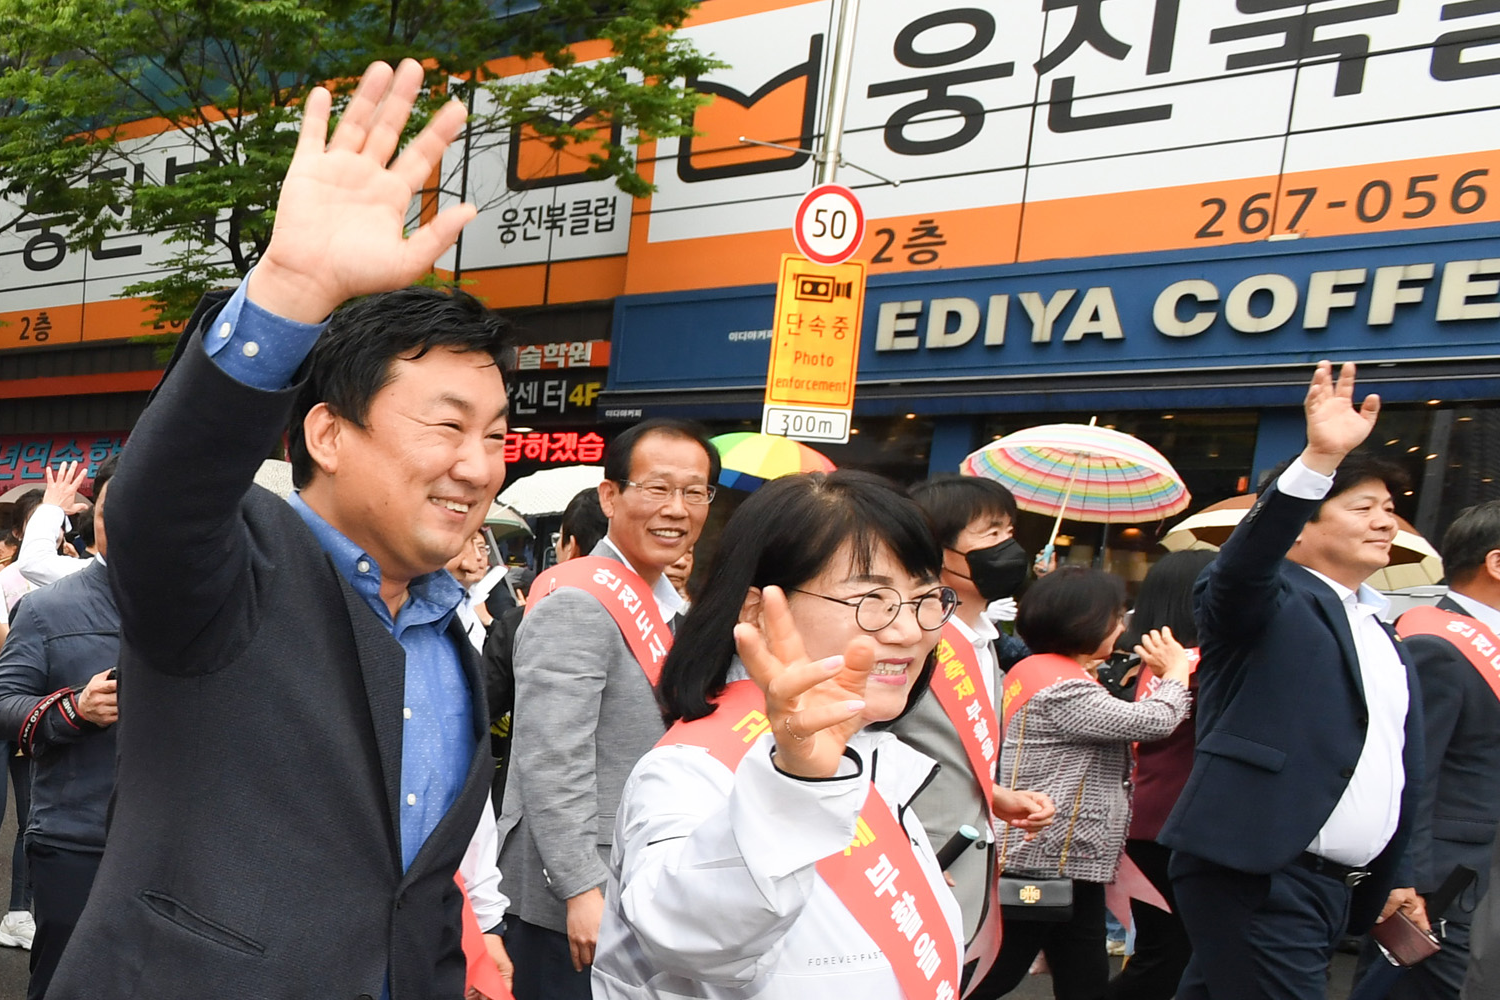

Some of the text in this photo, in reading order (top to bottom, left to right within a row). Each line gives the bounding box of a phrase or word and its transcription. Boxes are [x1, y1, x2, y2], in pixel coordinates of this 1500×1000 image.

[497, 195, 617, 244] 웅진북클럽
[1194, 168, 1490, 240] 267-056
[812, 208, 847, 240] 50
[870, 218, 947, 266] 2층
[18, 312, 53, 342] 2층
[786, 312, 850, 341] 단속중
[875, 285, 1126, 353] EDIYA
[513, 341, 592, 370] 술학원
[794, 350, 835, 368] Photo
[506, 379, 601, 415] 센터 4F
[775, 374, 847, 394] enforcement
[780, 414, 833, 434] 300m
[592, 567, 668, 664] 안전도시
[864, 853, 942, 981] 부활을
